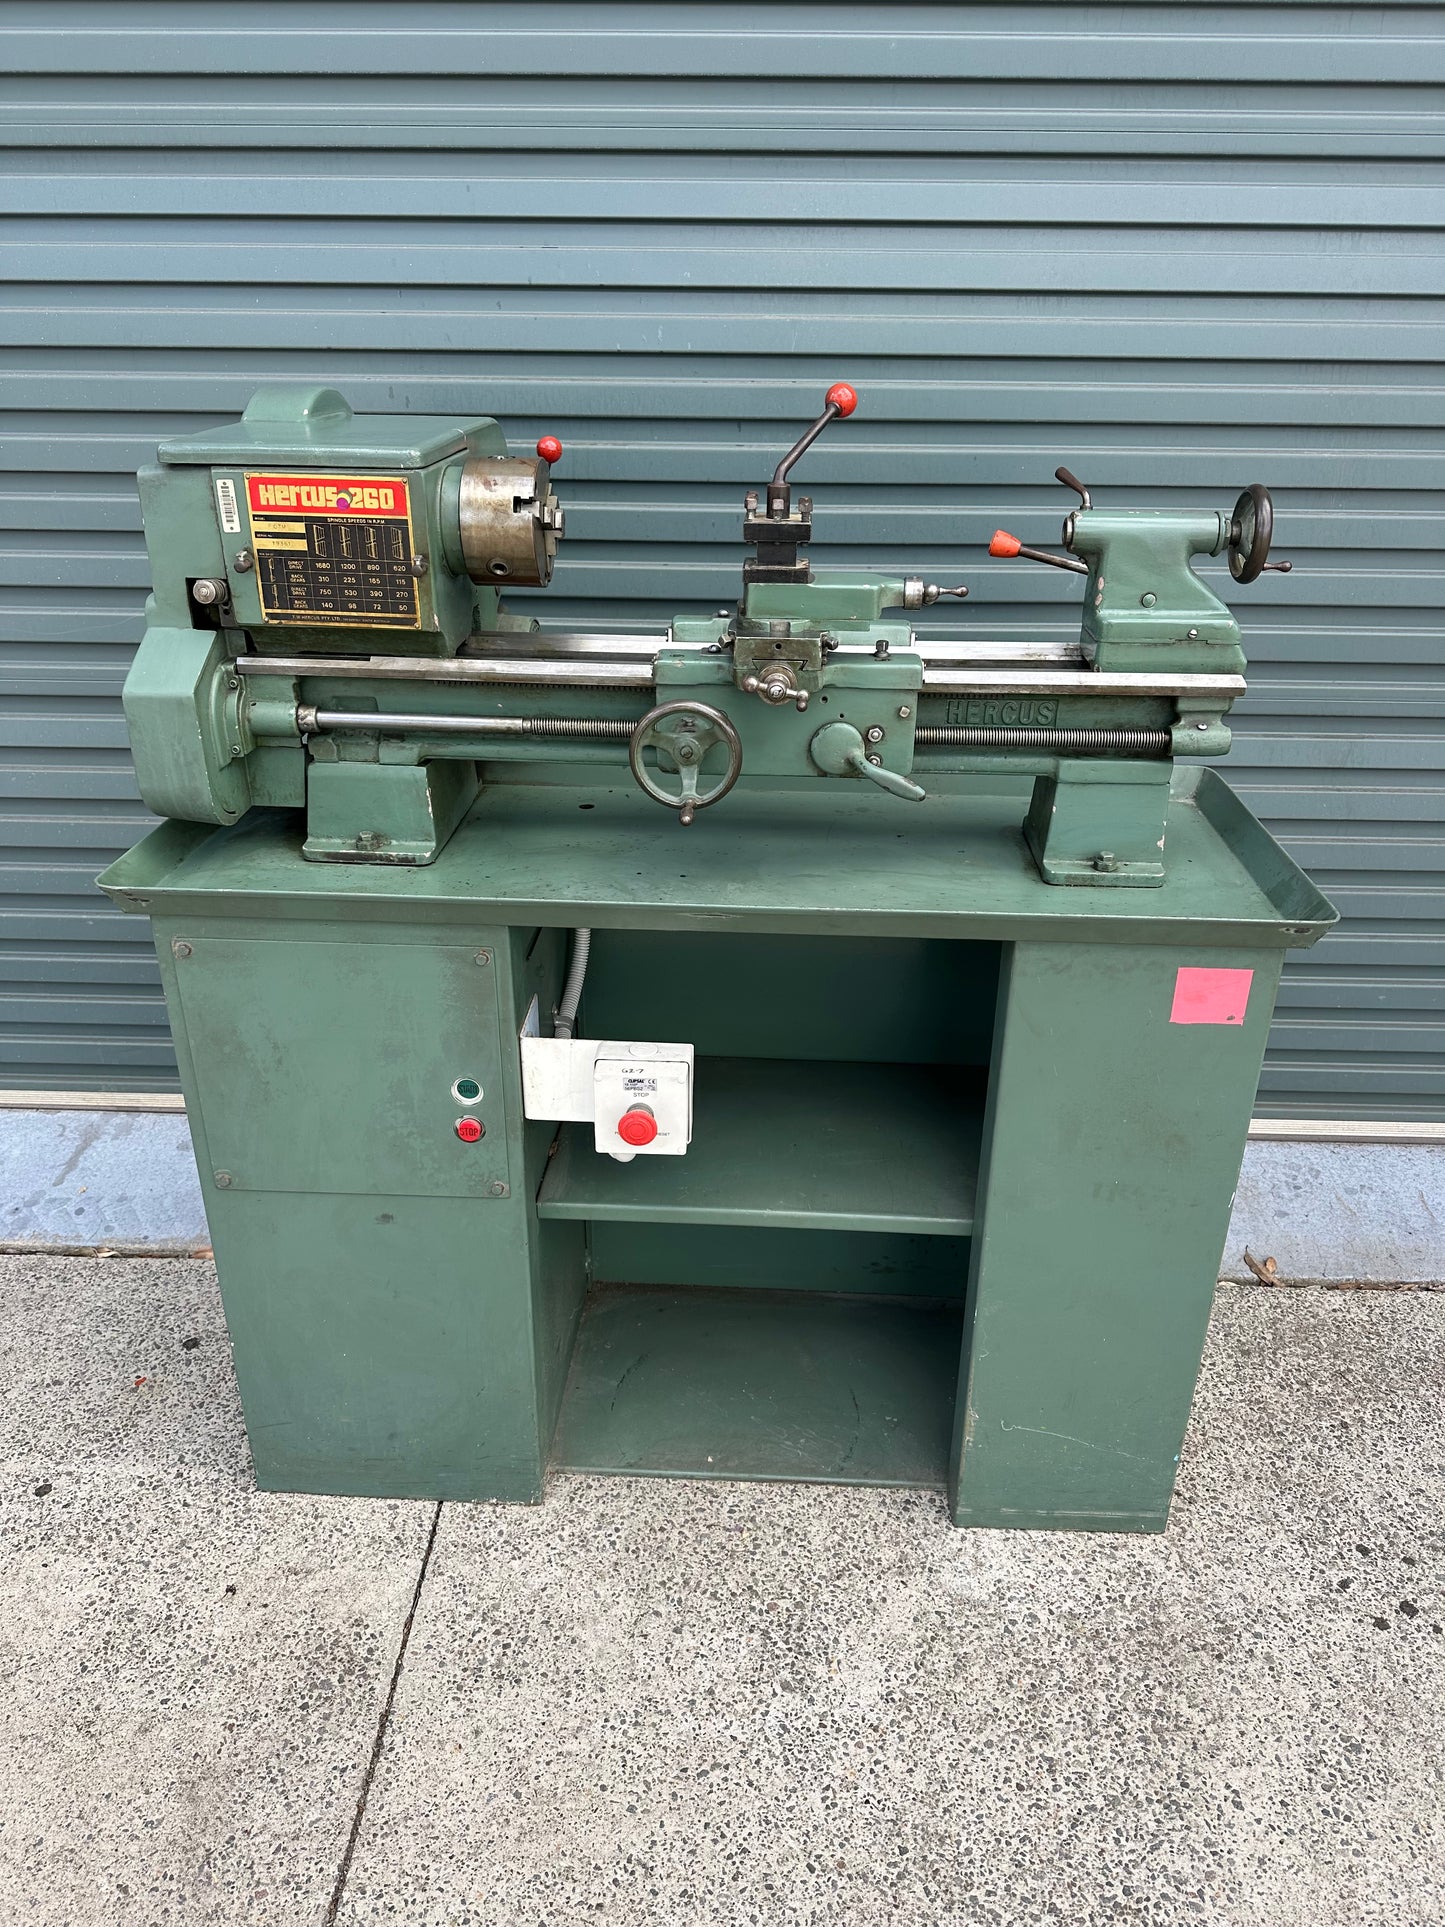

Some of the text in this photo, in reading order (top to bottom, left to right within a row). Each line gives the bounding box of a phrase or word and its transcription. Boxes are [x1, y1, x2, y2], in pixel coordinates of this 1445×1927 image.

[259, 484, 339, 507] Hercus
[350, 488, 395, 510] 260
[946, 699, 1056, 725] HERCUS
[460, 1127, 479, 1136] STOP
